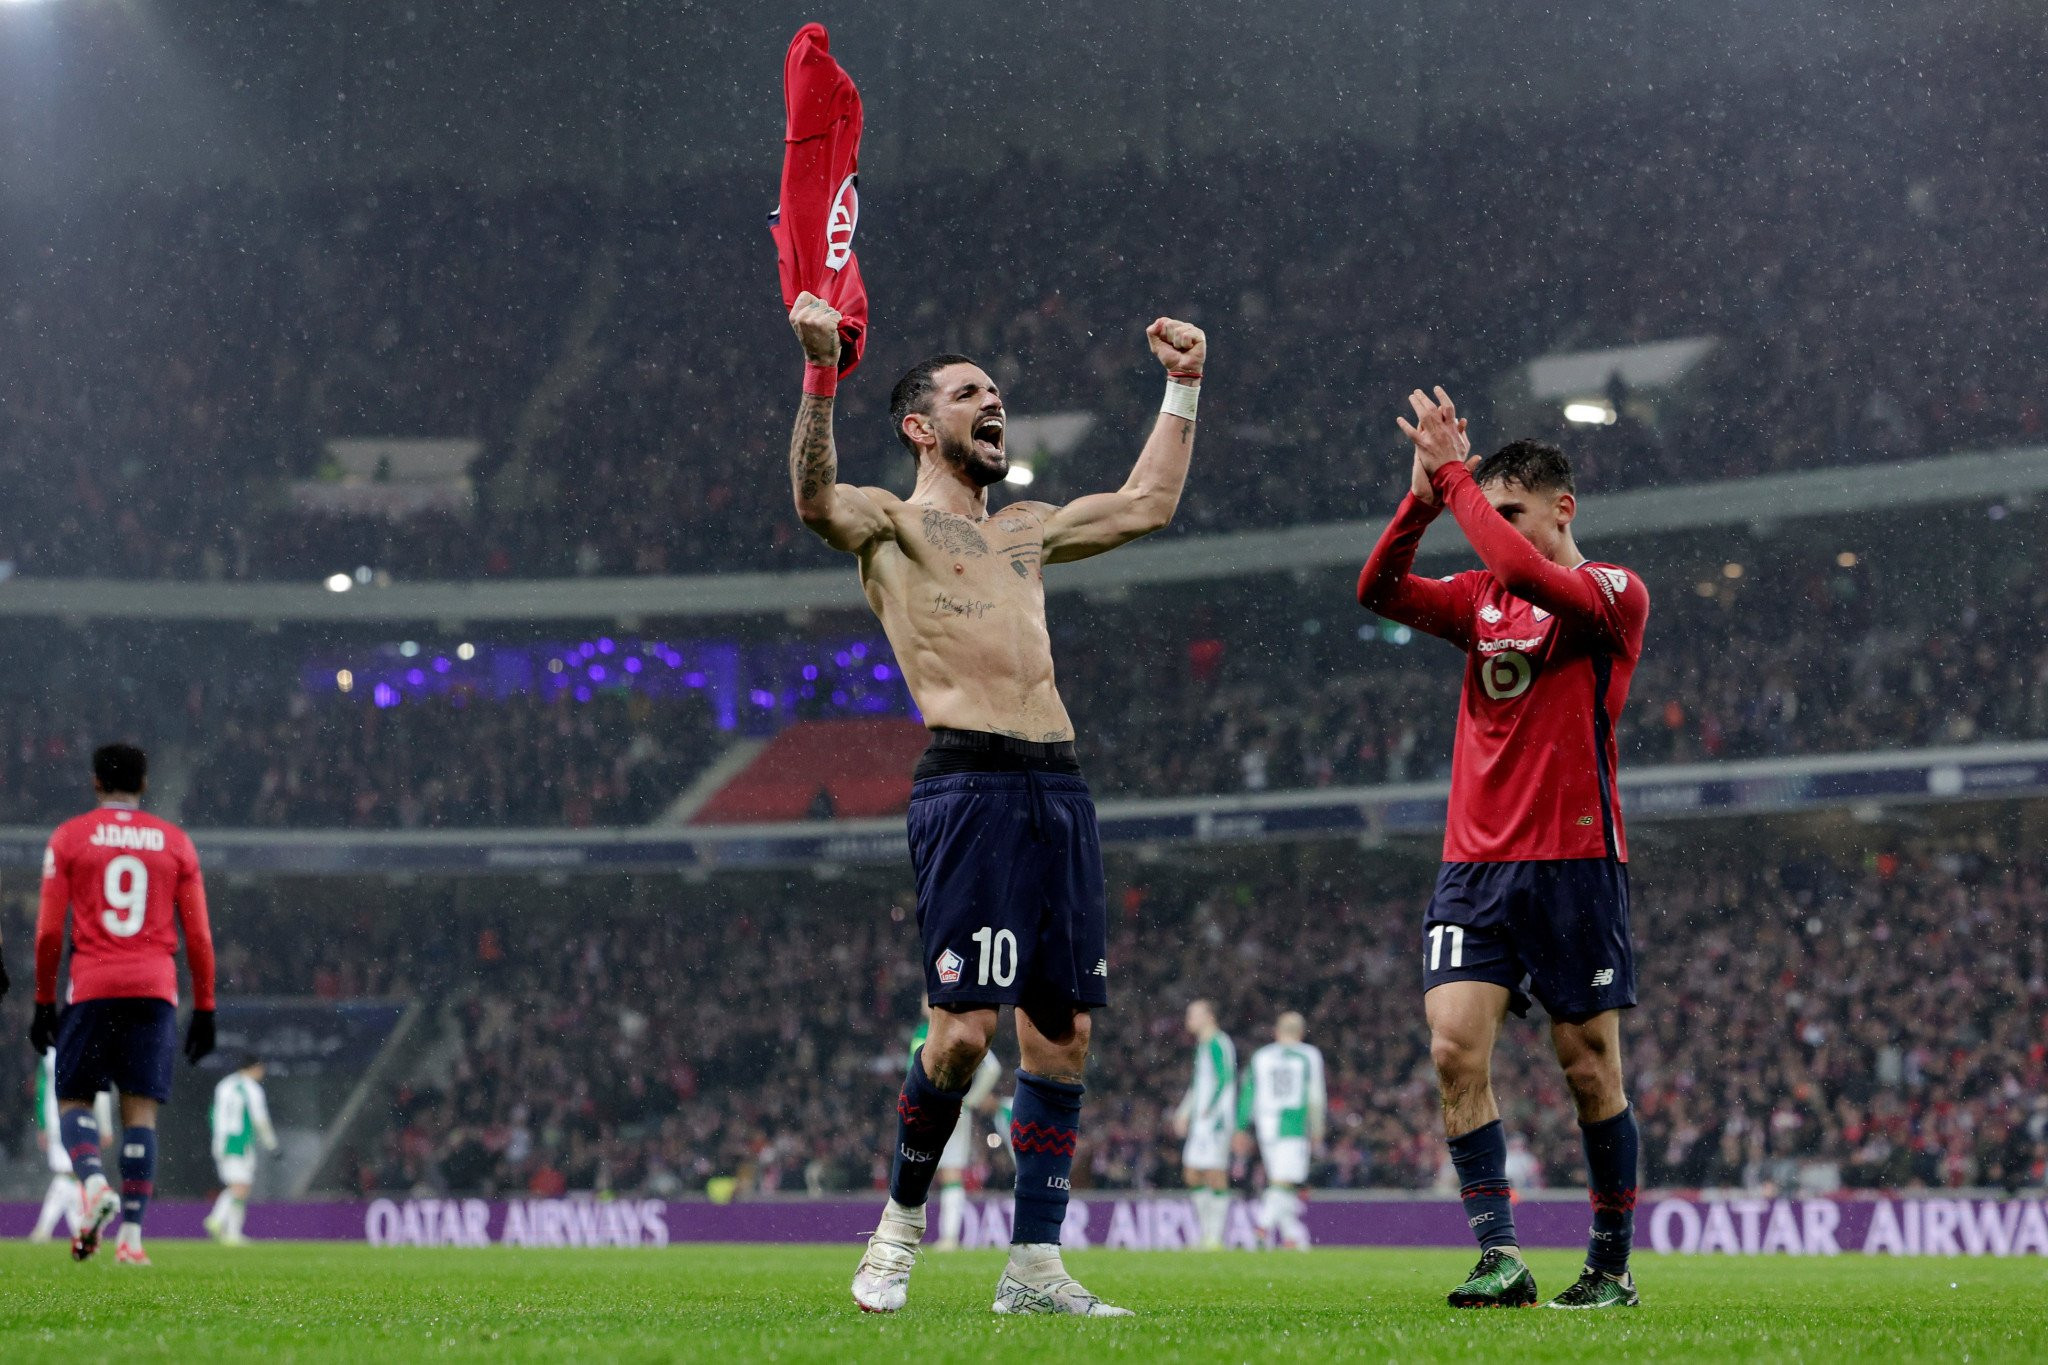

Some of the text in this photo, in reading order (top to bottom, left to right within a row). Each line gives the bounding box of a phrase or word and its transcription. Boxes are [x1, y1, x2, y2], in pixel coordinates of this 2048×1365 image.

[1477, 636, 1543, 652] boulanger
[90, 823, 165, 852] J.DAVID
[102, 855, 148, 938] 9
[972, 926, 1018, 988] 10
[1428, 924, 1465, 971] 11
[1046, 1176, 1072, 1191] LOS
[365, 1198, 669, 1248] QATAR AIRWAYS
[1649, 1198, 2048, 1256] QATAR AIRWA
